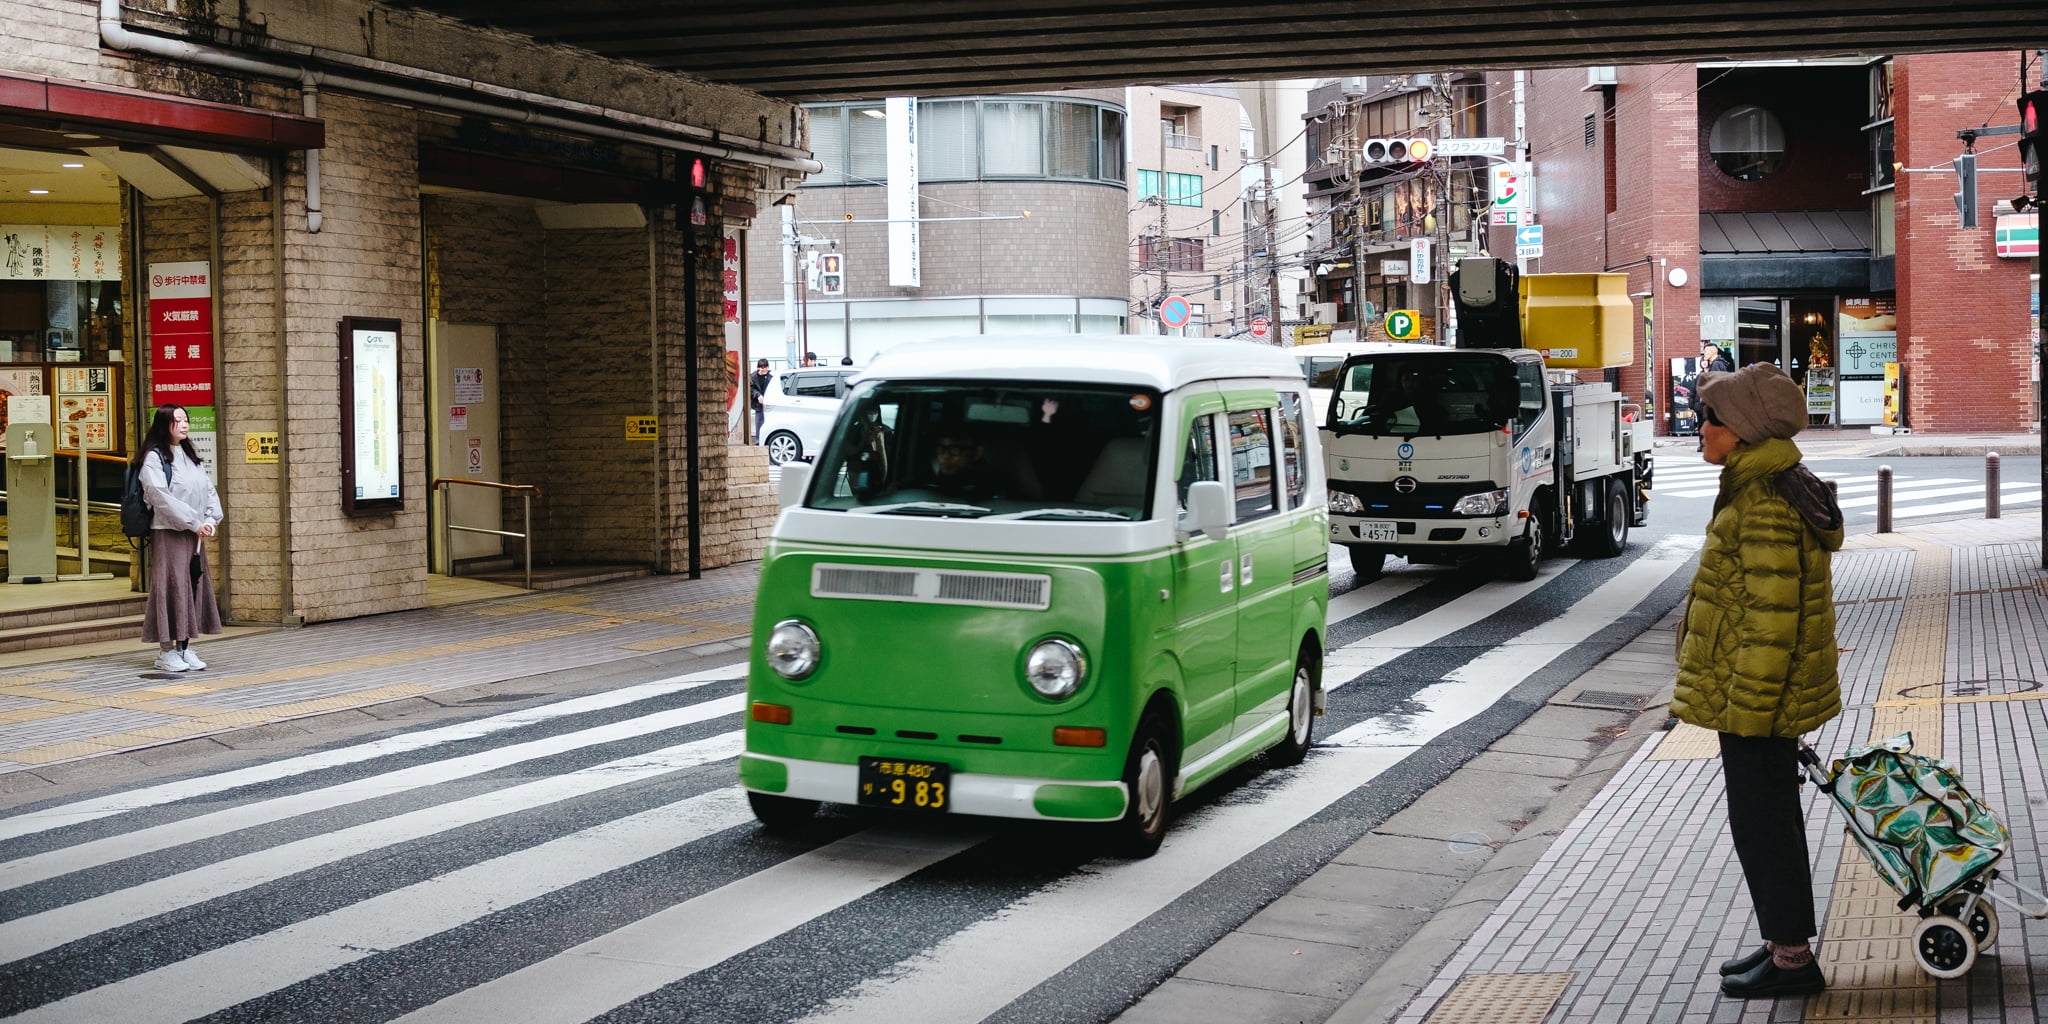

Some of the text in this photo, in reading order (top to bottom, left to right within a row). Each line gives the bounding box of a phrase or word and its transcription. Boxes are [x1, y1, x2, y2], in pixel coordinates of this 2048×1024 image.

[164, 275, 207, 286] 歩行中禁煙
[163, 310, 199, 322] 火気厳禁
[1395, 316, 1409, 335] P
[1560, 349, 1573, 358] 200
[155, 382, 212, 392] 危険物品持込み厳禁
[1368, 529, 1395, 540] 45-77
[907, 764, 932, 778] 480
